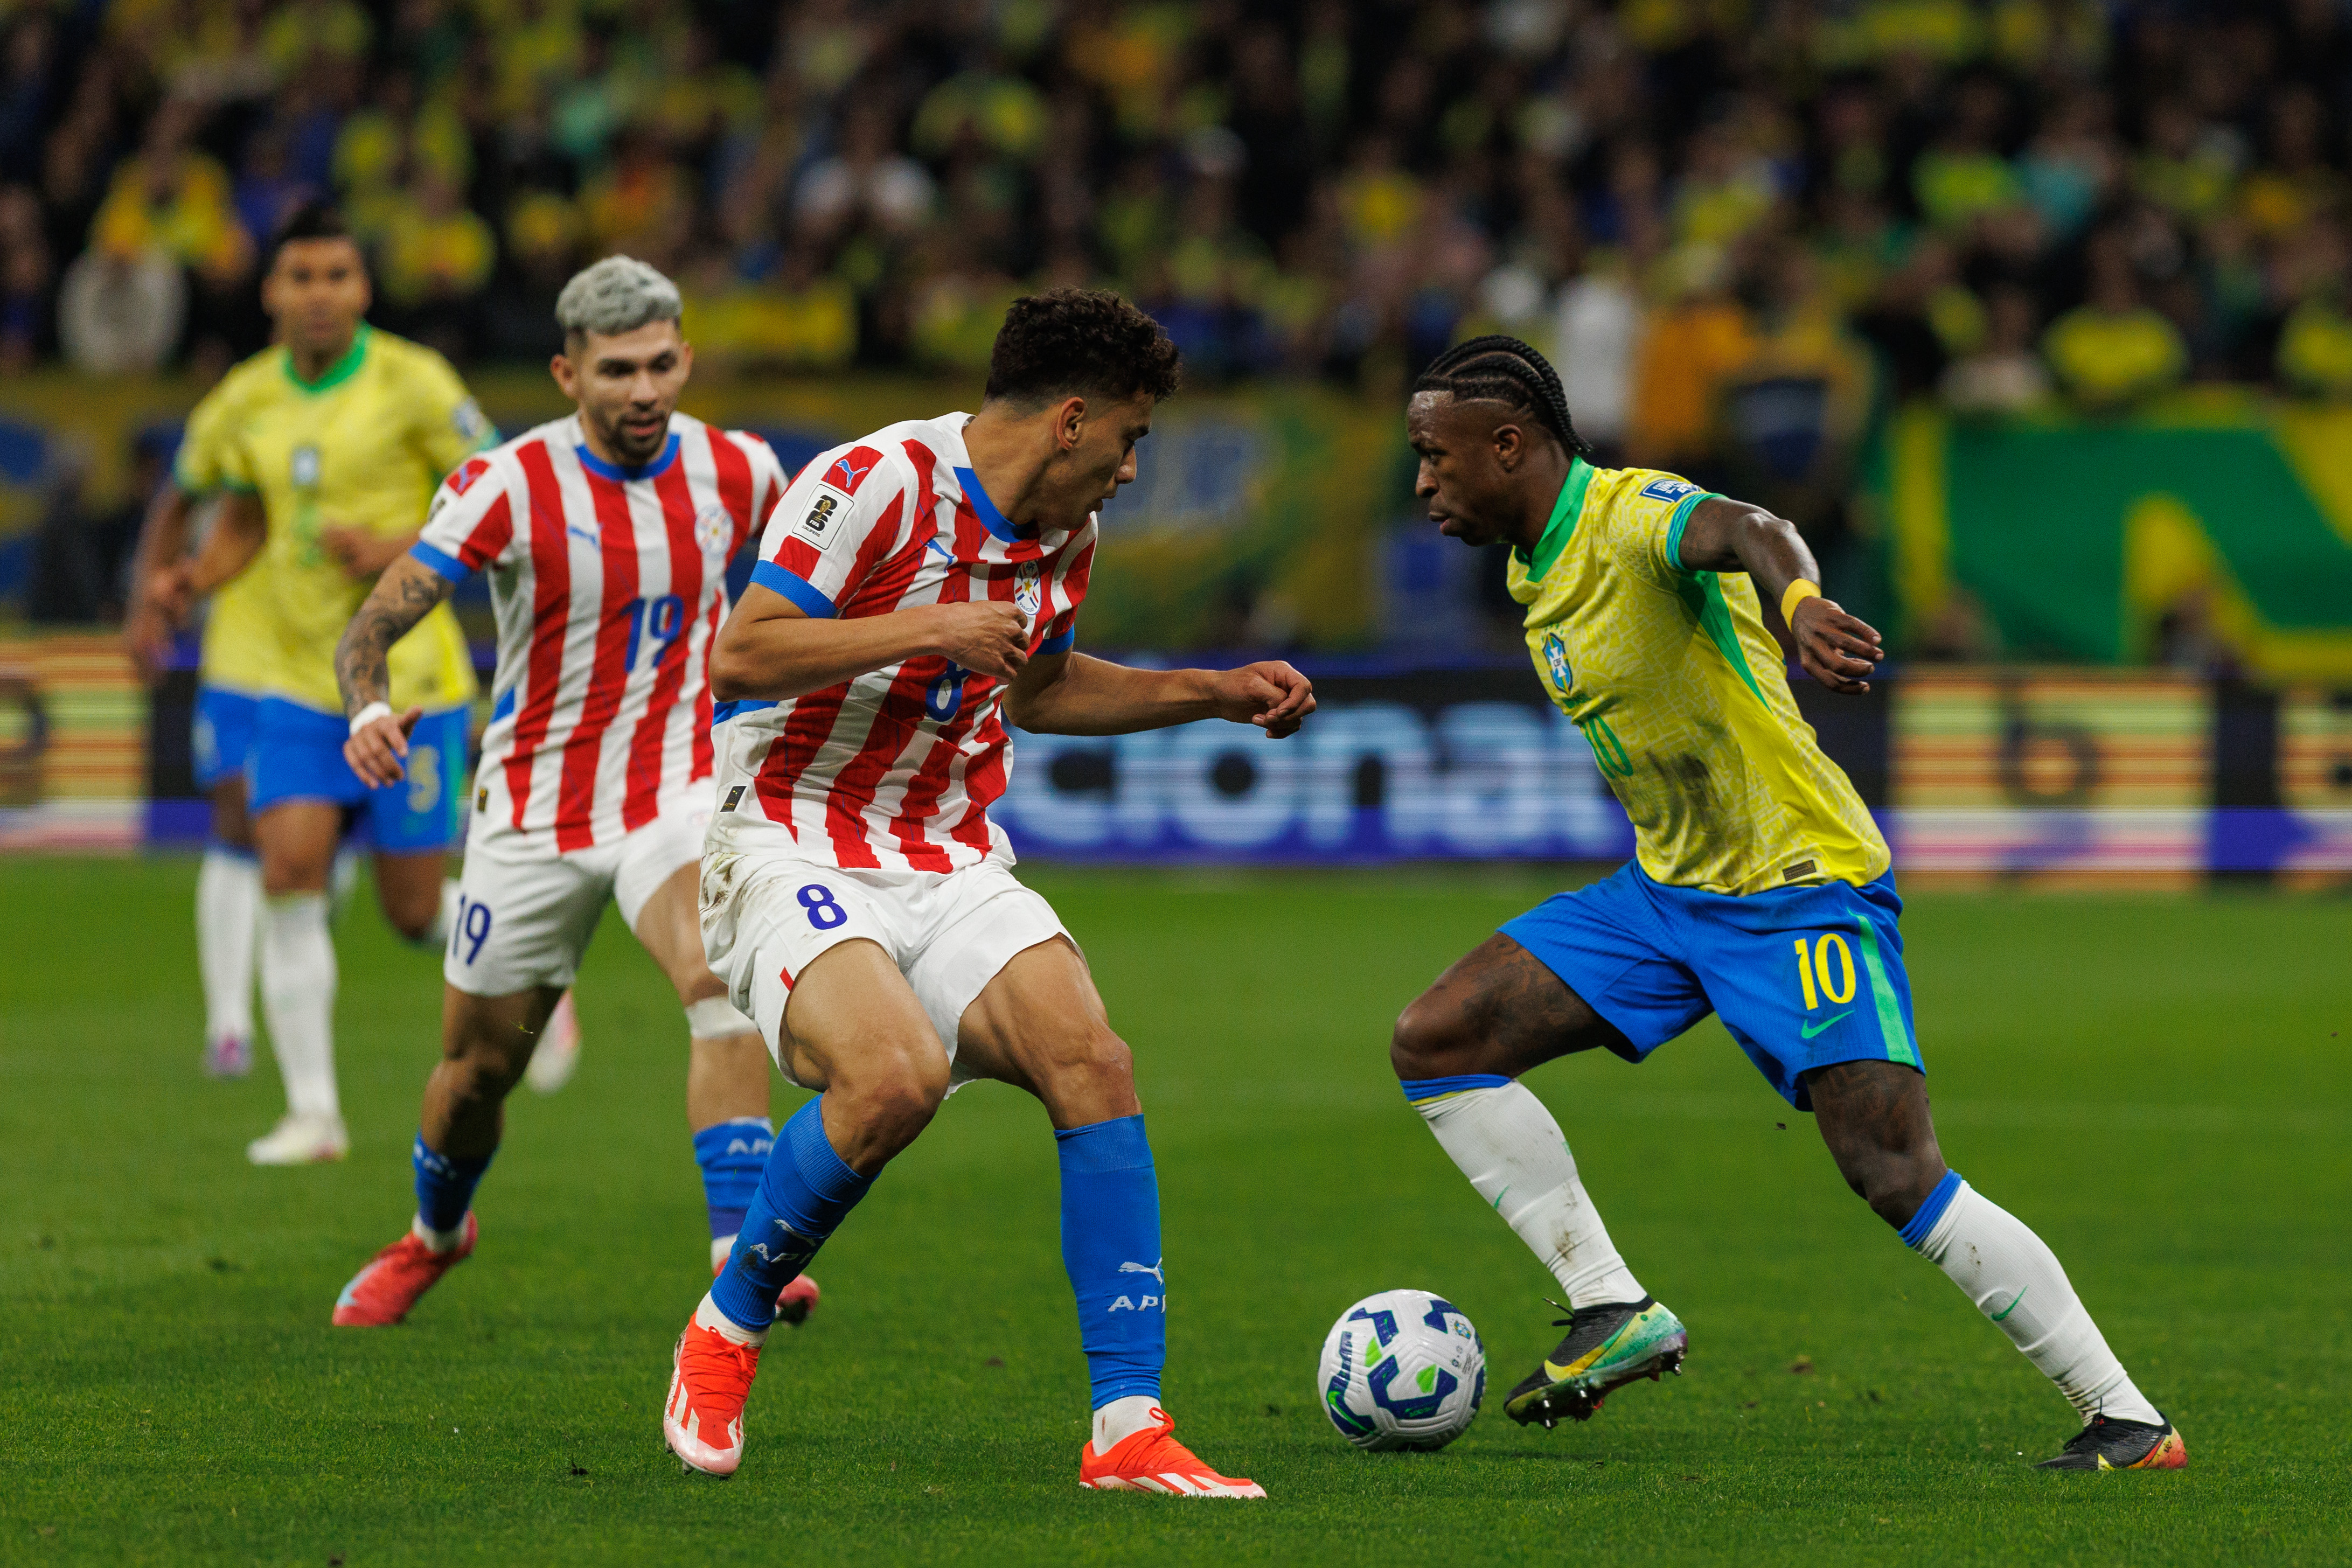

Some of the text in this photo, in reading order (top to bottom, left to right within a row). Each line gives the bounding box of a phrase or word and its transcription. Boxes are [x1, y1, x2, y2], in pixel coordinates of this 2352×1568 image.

[809, 519, 819, 528] FIFA
[620, 594, 684, 673] 19
[452, 893, 491, 967] 19
[796, 883, 848, 930] 8
[1794, 933, 1856, 1011] 10
